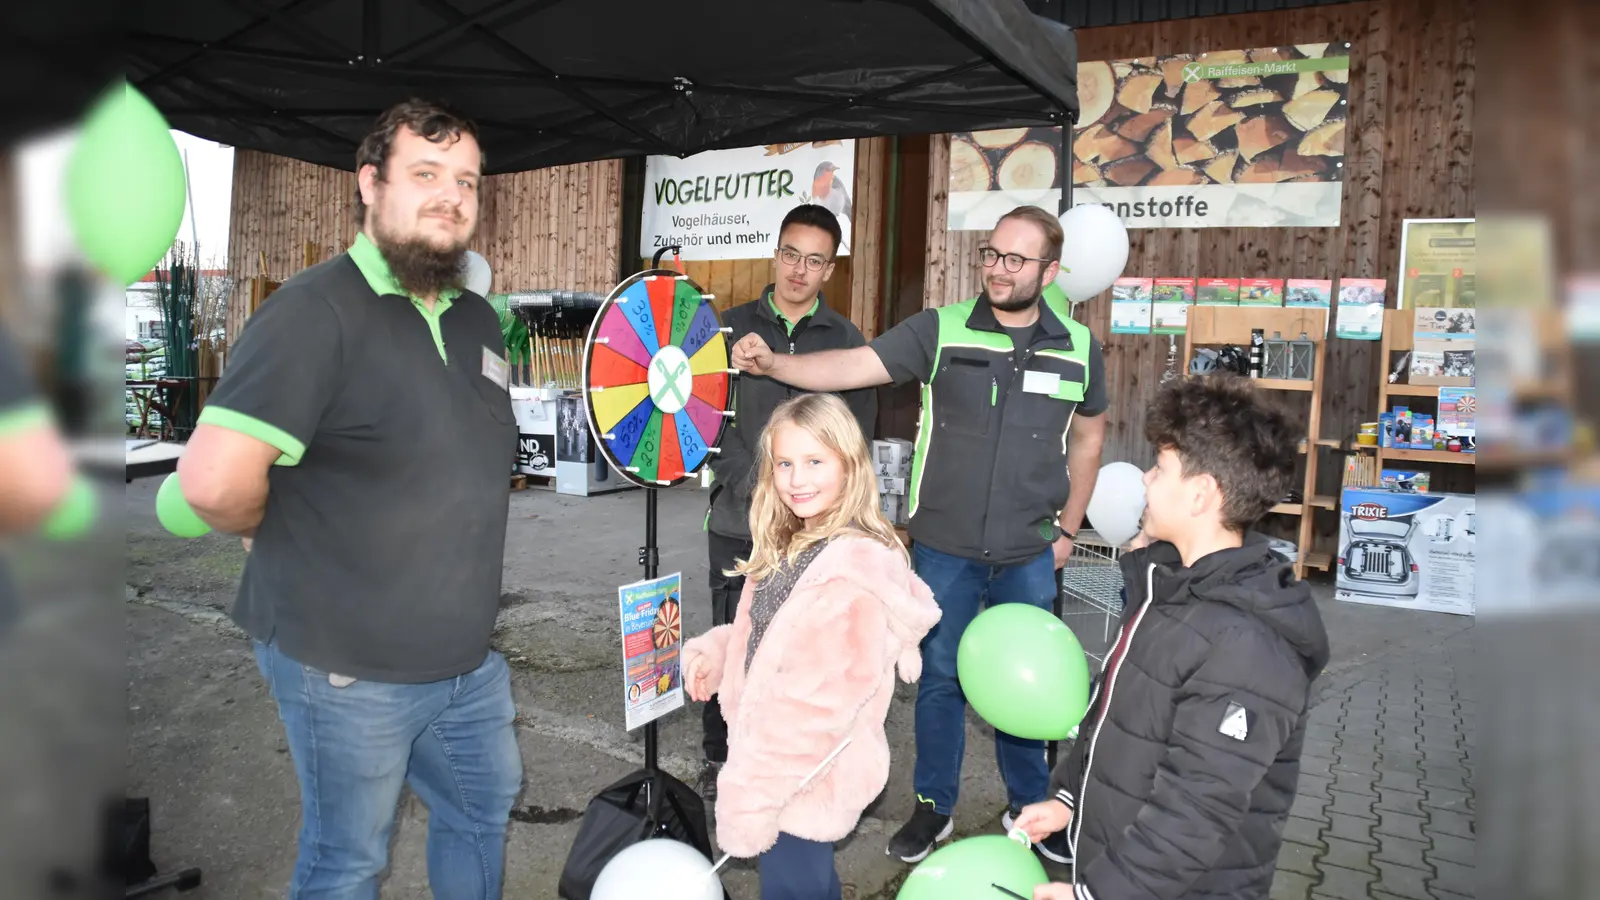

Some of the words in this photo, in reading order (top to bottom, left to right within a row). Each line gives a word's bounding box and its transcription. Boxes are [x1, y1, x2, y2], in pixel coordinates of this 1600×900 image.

[1208, 62, 1297, 77] Raiffeisen-Markt
[655, 168, 795, 206] VOGELFUTTER
[672, 212, 750, 230] Vogelhäuser,
[654, 232, 703, 248] Zubehör
[707, 231, 732, 246] und
[736, 230, 771, 244] mehr
[632, 299, 654, 336] 30%
[675, 297, 691, 333] 20%
[690, 315, 712, 348] 50%
[520, 438, 540, 453] ND
[620, 411, 643, 449] 50%
[680, 423, 699, 457] 30%
[640, 428, 656, 467] 20%
[1351, 505, 1388, 518] TRIXIE
[624, 611, 641, 623] Blue
